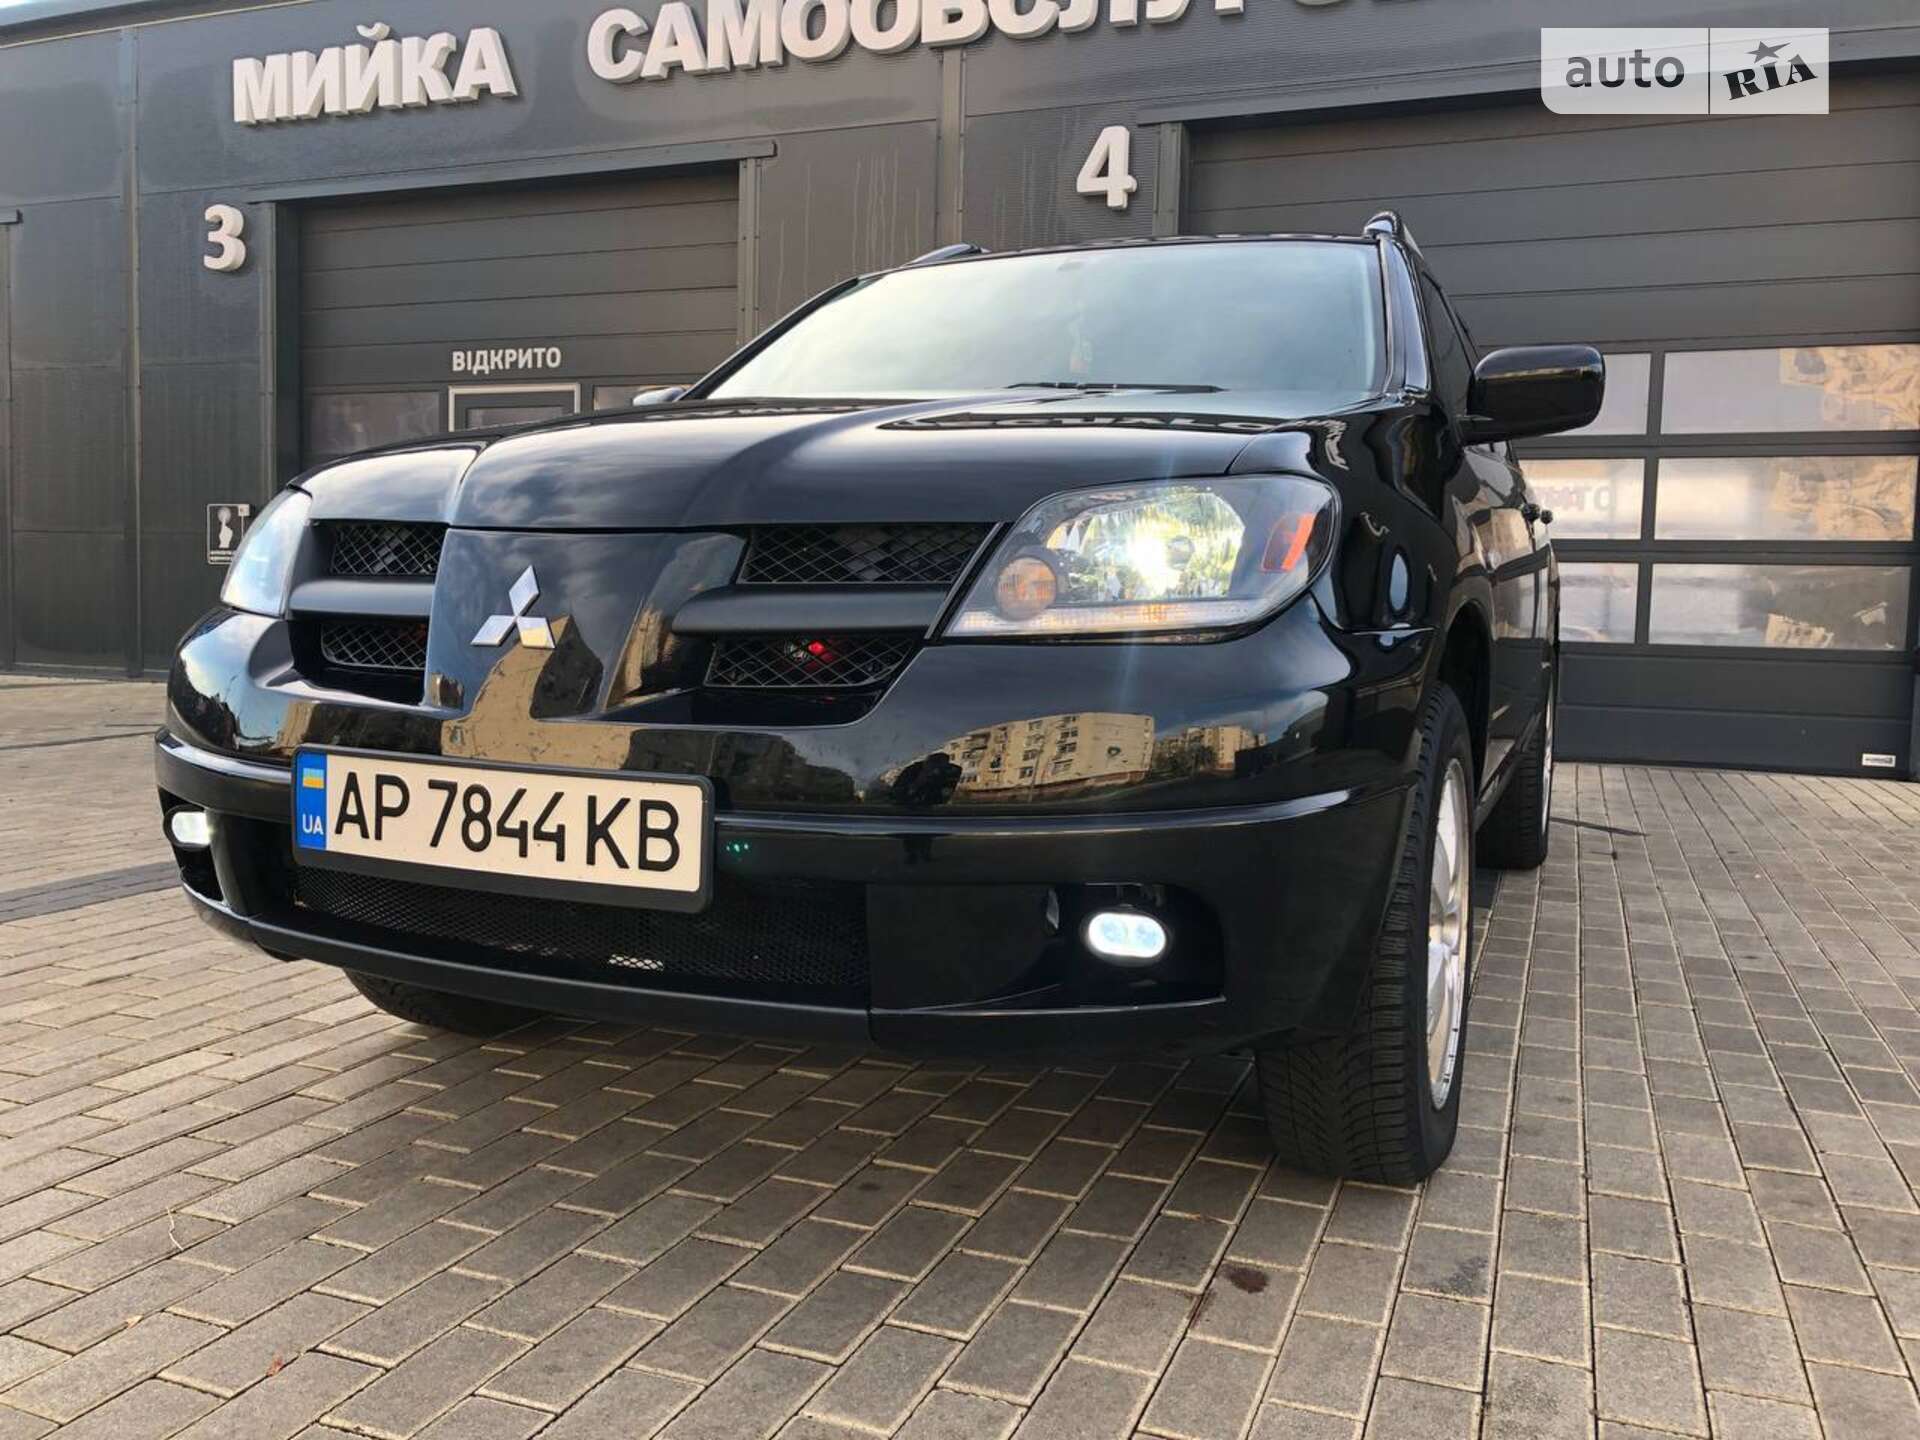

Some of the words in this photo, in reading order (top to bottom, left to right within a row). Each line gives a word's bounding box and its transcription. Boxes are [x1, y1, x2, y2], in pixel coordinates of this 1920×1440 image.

[232, 22, 517, 125] МИЙКА
[1076, 125, 1137, 210] 4
[203, 204, 247, 272] 3
[452, 347, 561, 375] ВІДКРИТО
[301, 813, 324, 836] UA
[334, 771, 410, 841] AP
[428, 779, 566, 862] 7844
[585, 795, 681, 873] KB
